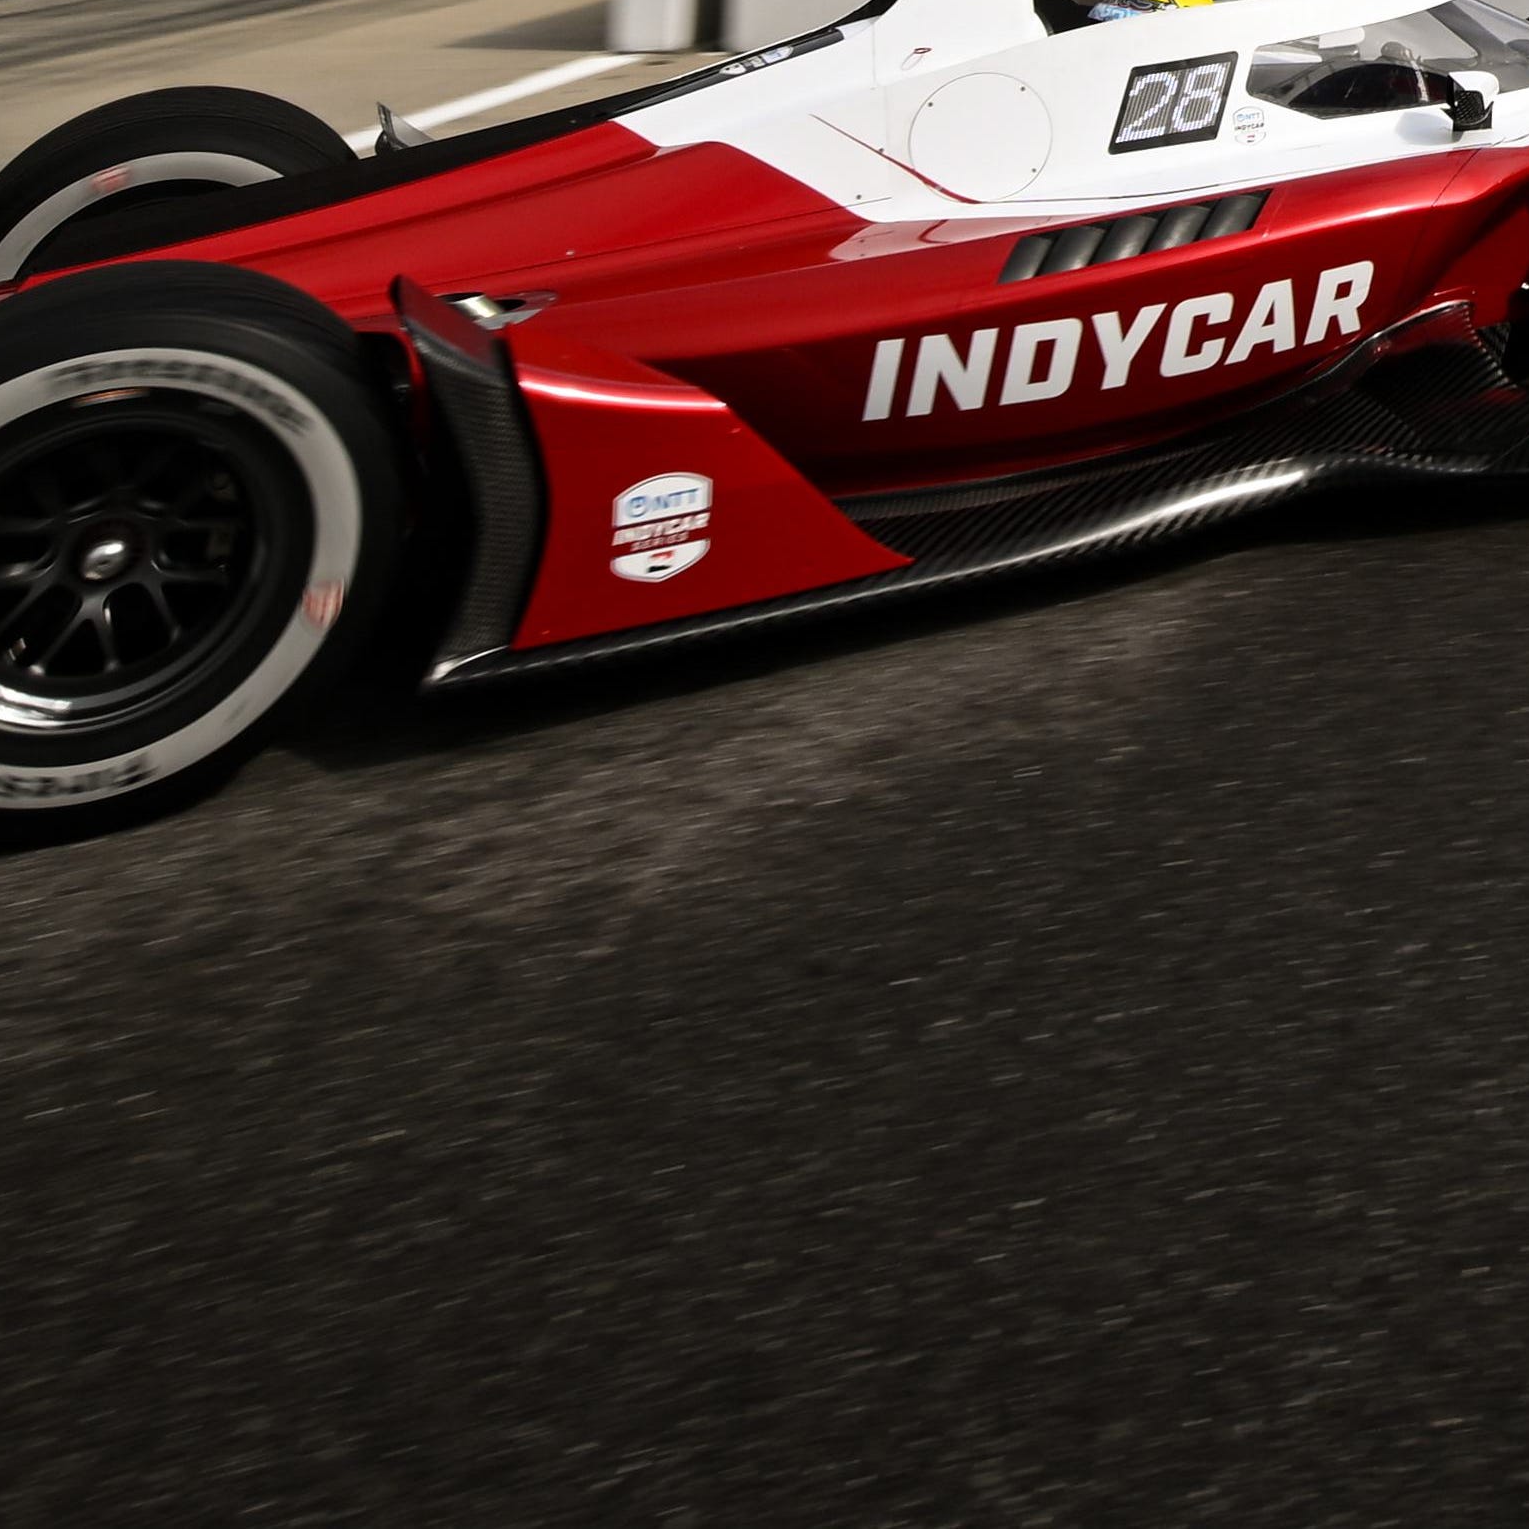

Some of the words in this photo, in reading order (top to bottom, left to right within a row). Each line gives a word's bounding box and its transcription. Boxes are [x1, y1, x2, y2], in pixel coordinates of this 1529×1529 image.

[1115, 62, 1226, 144] 28
[862, 260, 1374, 422] INDYCAR
[652, 487, 700, 511] NTT
[612, 512, 711, 547] INDYCAR
